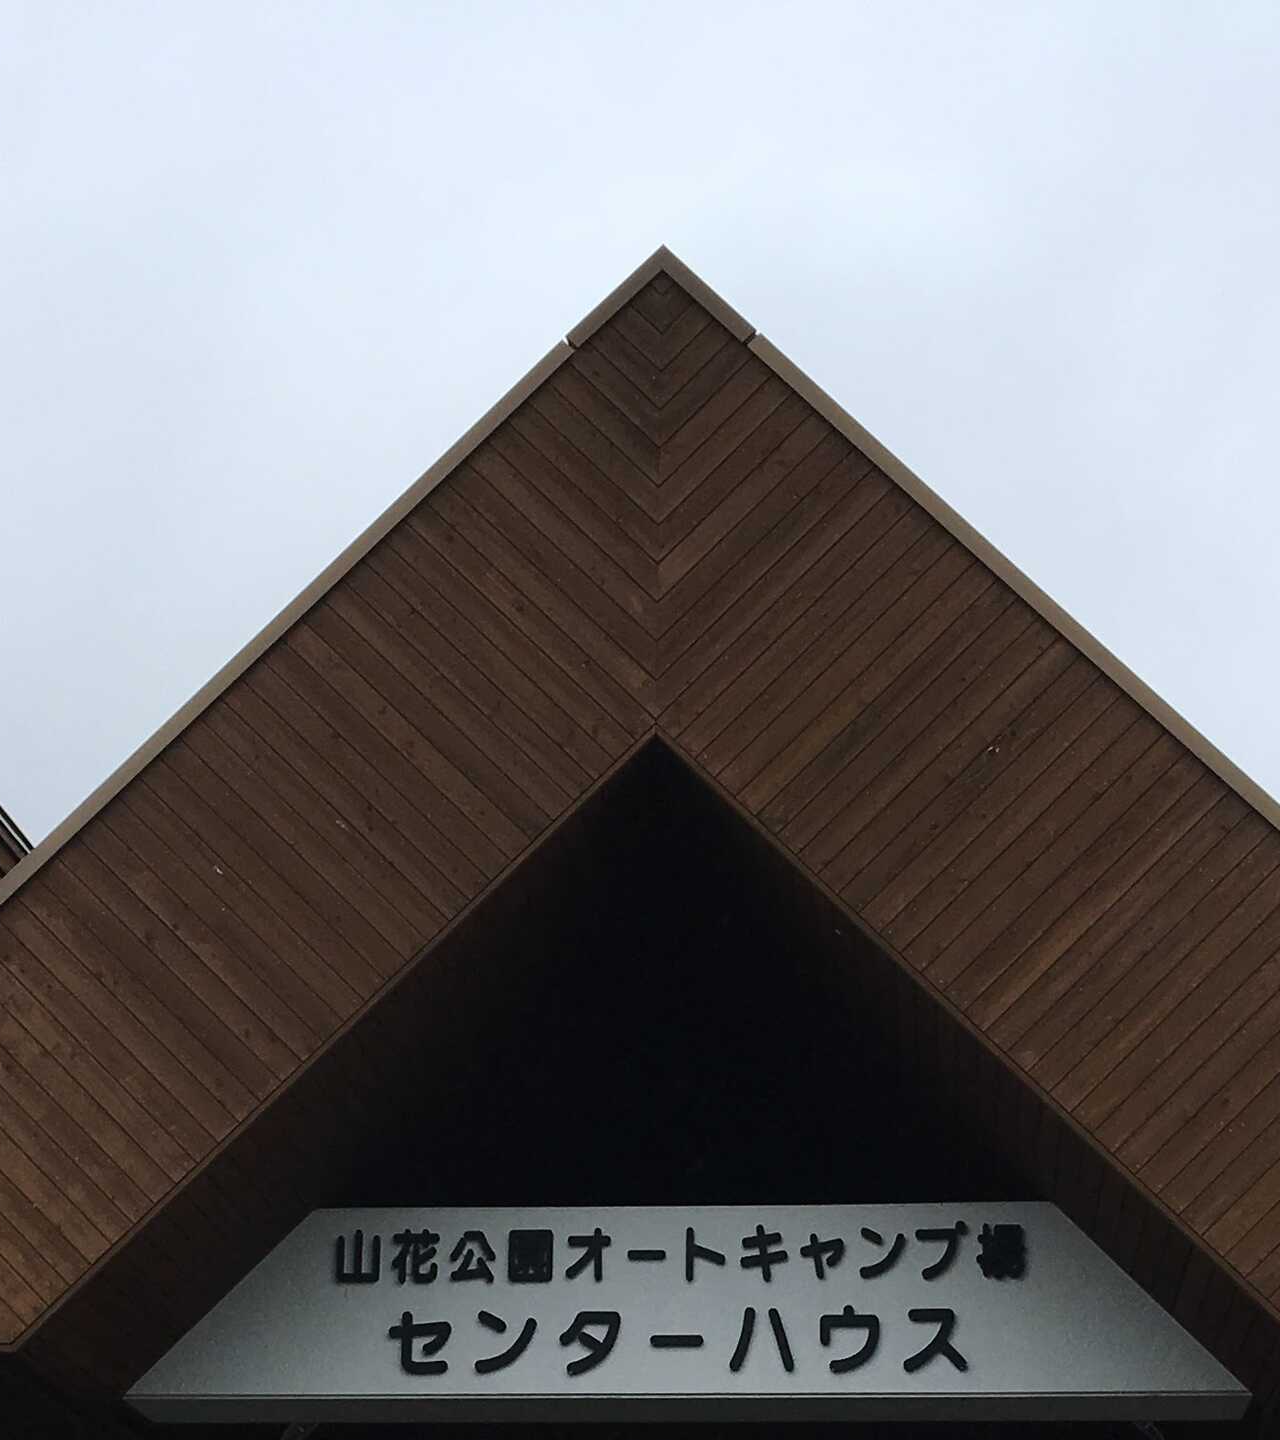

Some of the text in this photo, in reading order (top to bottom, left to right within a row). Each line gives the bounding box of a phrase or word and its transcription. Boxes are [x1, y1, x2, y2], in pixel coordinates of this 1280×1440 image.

[335, 1220, 1026, 1284] 山花公園オートキャンプ場
[389, 1304, 969, 1376] センターハウス
